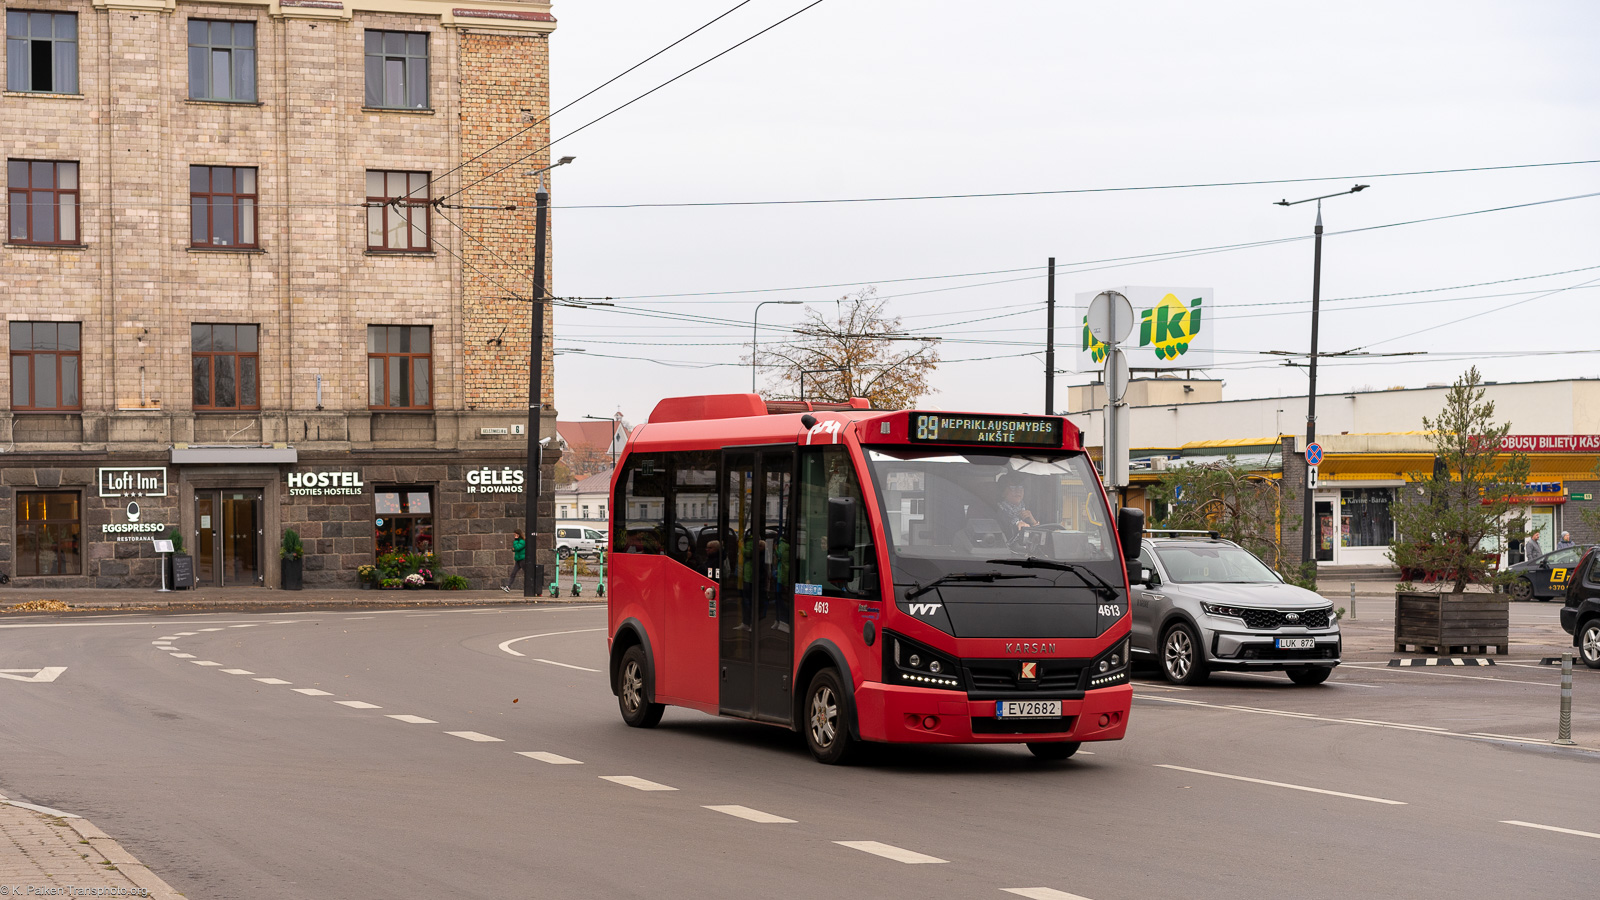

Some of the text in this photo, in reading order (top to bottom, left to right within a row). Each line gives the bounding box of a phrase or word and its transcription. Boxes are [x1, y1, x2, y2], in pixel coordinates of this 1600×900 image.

[1139, 297, 1202, 347] iki
[515, 425, 520, 433] 6
[917, 415, 1052, 440] 89 NEPRIKLAUSOMYBĖS
[977, 430, 1015, 443] AIKŠTĖ
[1539, 437, 1577, 450] BILIETŲ
[108, 471, 158, 490] Loft Inn
[288, 472, 364, 488] HOSTEL
[466, 466, 525, 485] GĖLĖS
[290, 487, 362, 496] STOTIES HOSTELIS
[480, 486, 523, 494] DOVANOS
[102, 522, 165, 533] EGGSPRESSO
[813, 601, 829, 614] 4613
[909, 603, 942, 616] VVT
[1098, 604, 1120, 617] 4613
[1005, 643, 1056, 654] KARSAN
[1280, 639, 1297, 648] LUK
[1300, 639, 1314, 648] 872
[1008, 702, 1056, 715] EV2682
